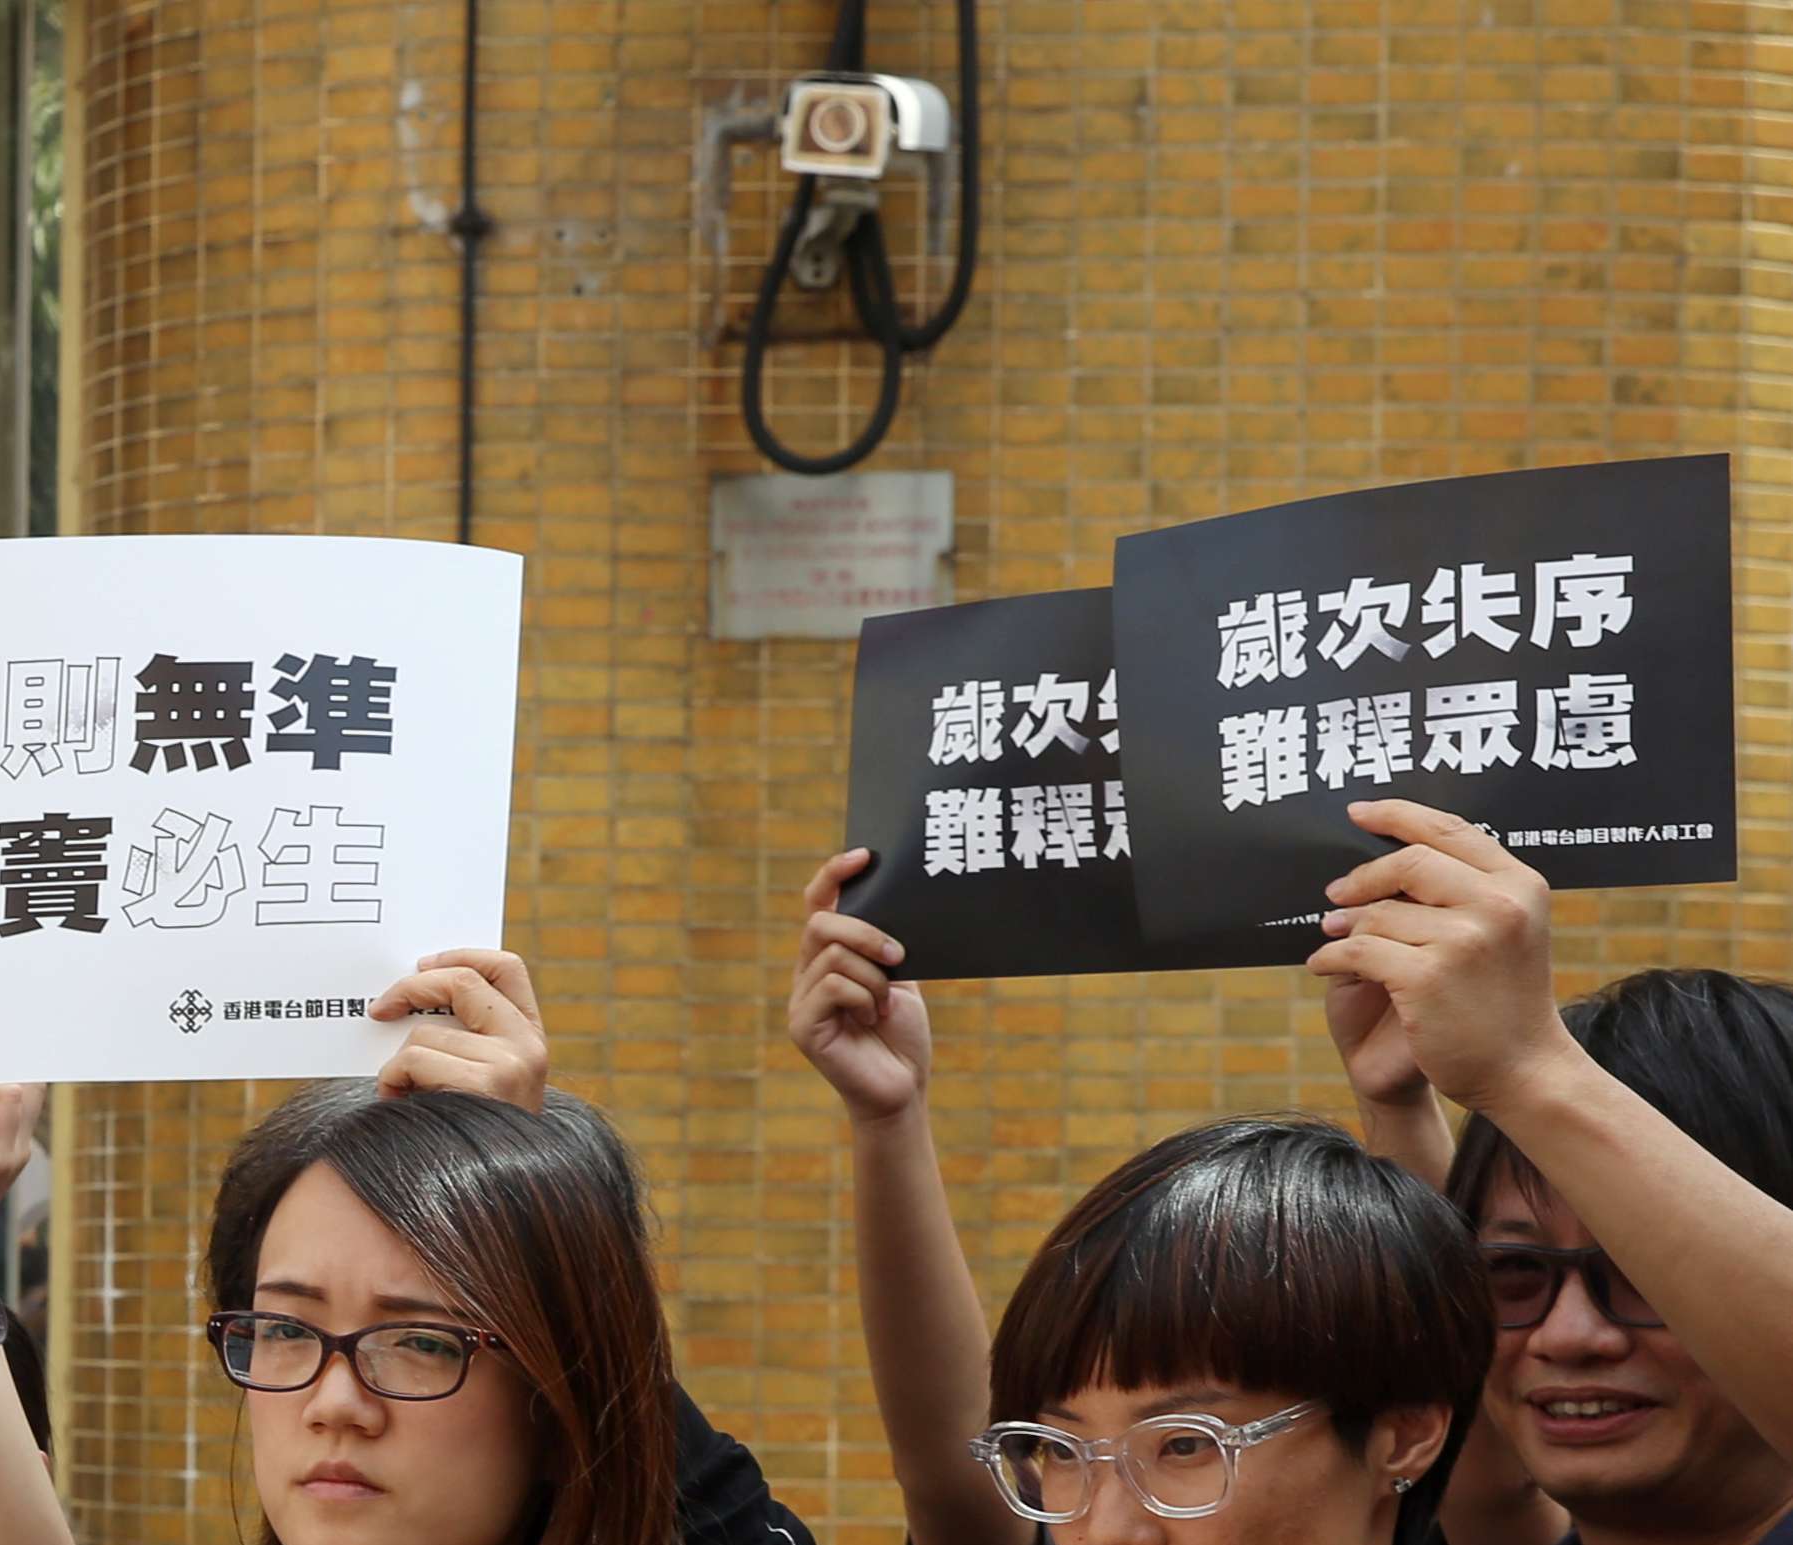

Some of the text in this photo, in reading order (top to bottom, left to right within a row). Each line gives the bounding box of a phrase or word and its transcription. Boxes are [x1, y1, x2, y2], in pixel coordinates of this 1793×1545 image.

[1216, 553, 1635, 690] 歲次失序
[927, 668, 1120, 765] 歲次
[1217, 671, 1638, 813] 難釋眾慮
